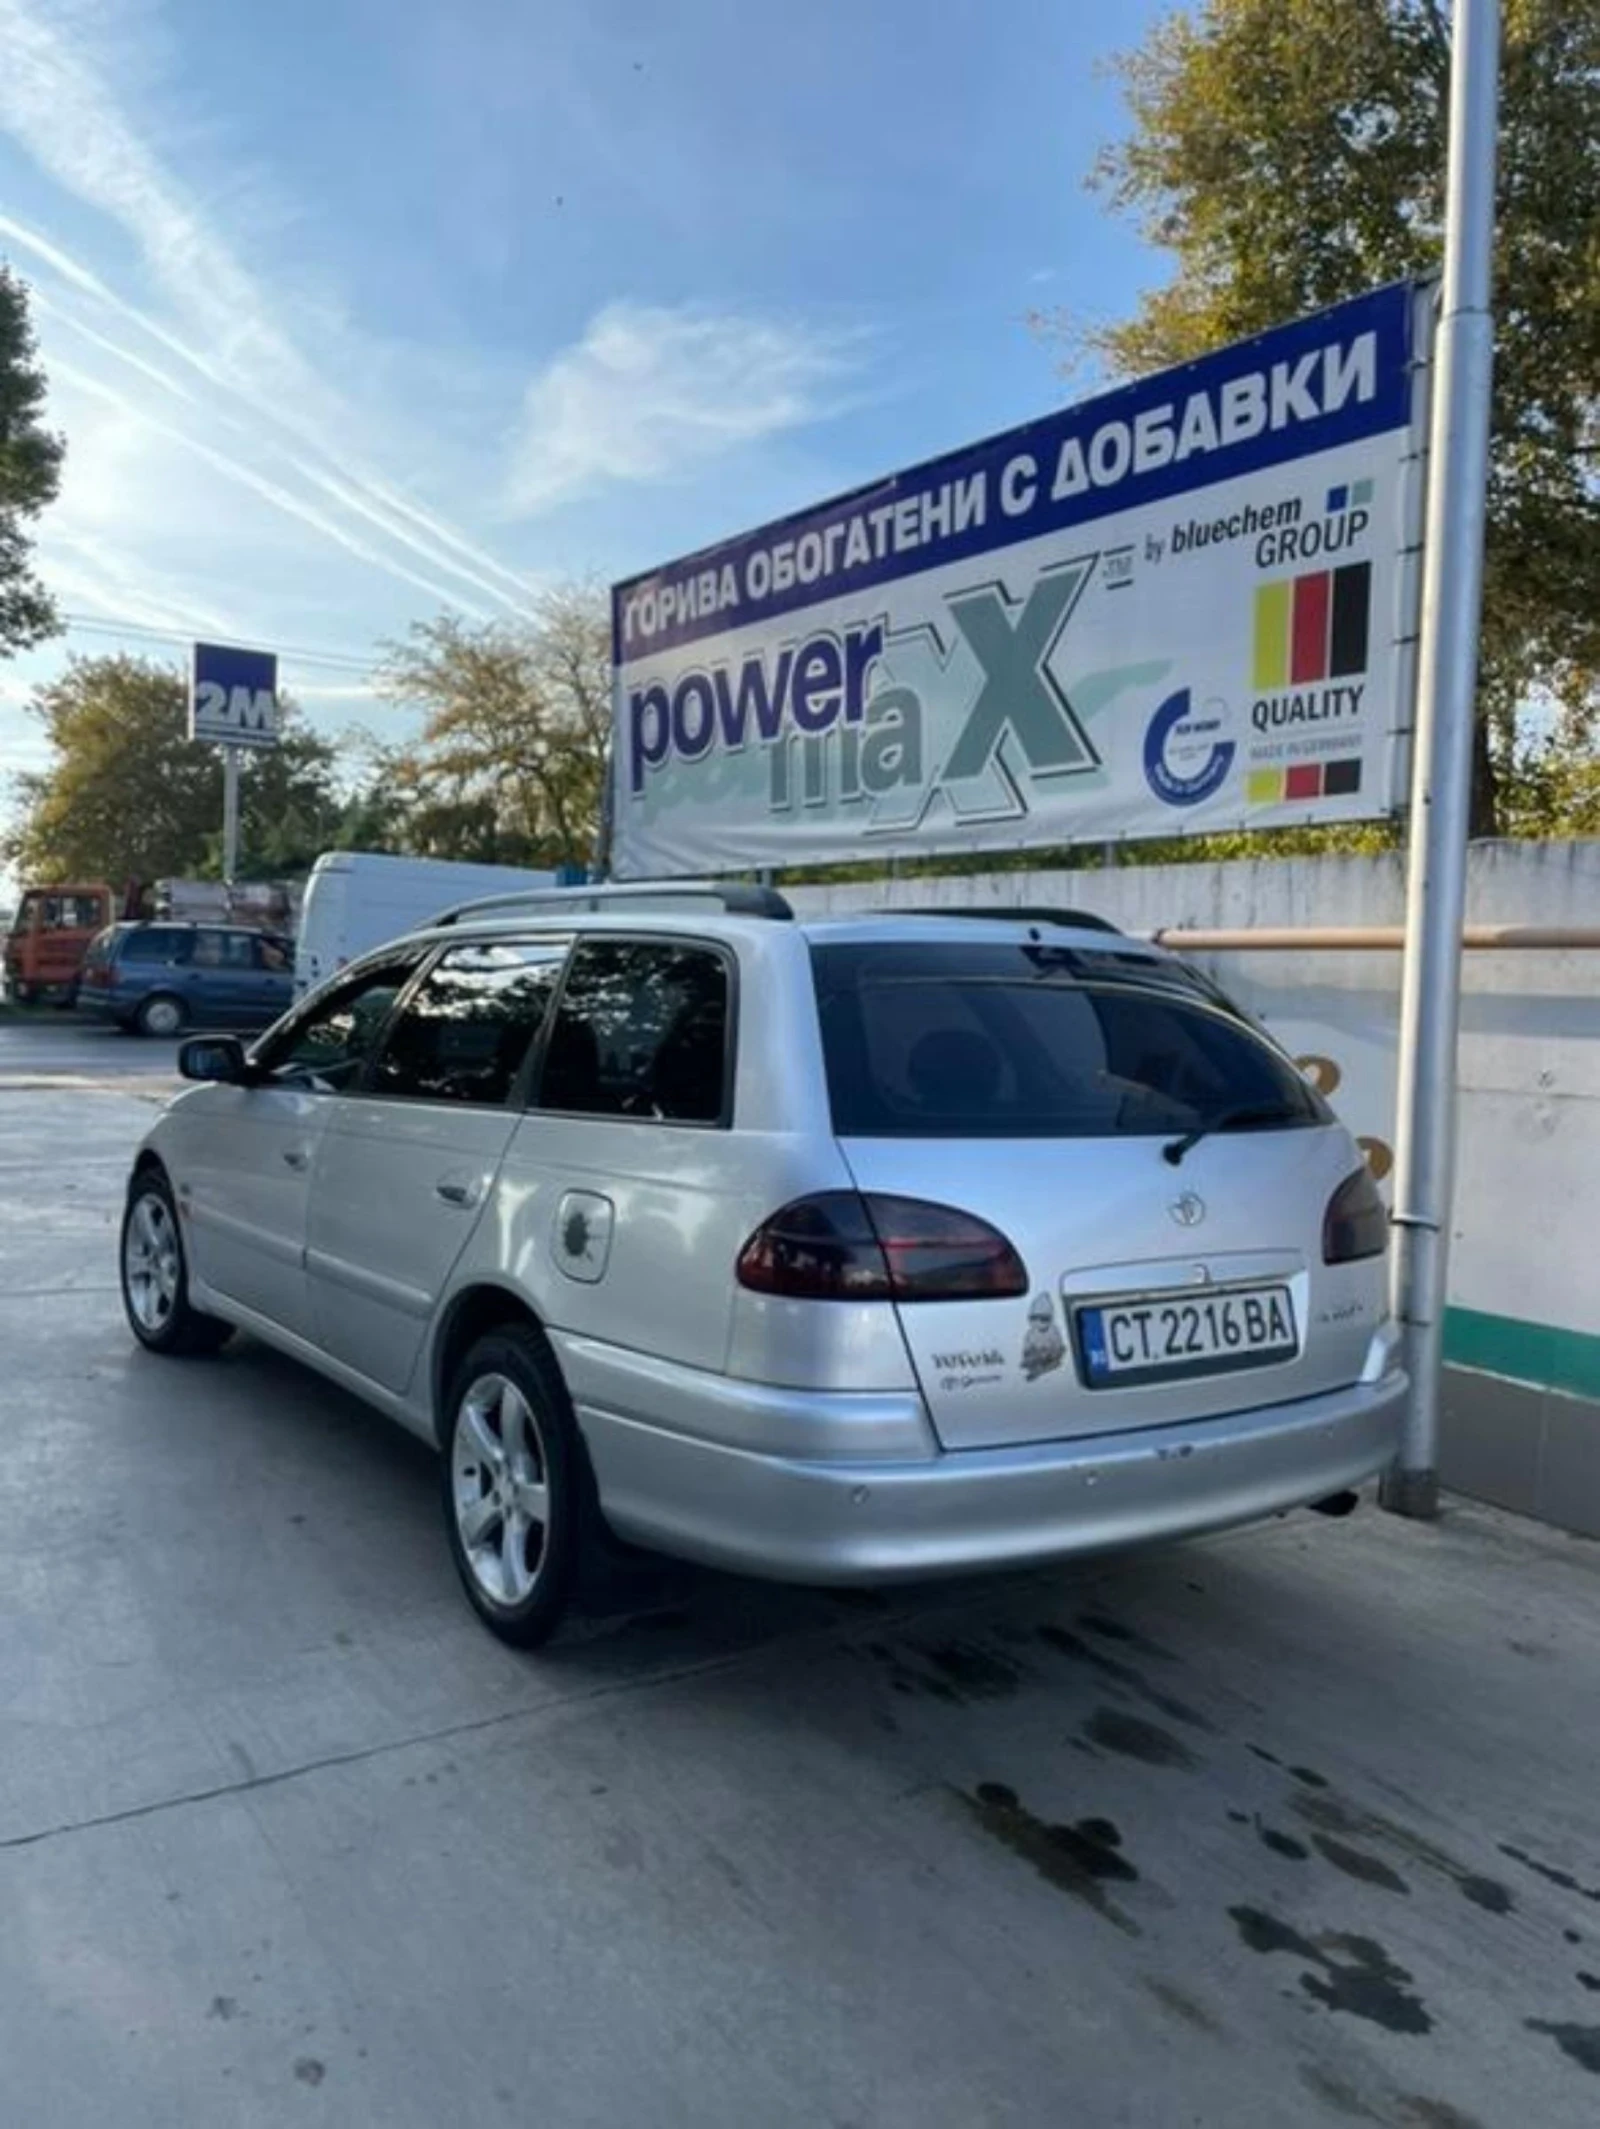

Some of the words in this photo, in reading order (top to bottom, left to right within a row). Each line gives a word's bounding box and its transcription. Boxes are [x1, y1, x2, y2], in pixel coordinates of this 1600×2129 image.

[623, 562, 740, 642] ГОРИВА
[746, 471, 987, 600] ОБОГАТЕНИ
[1002, 454, 1038, 516] С
[1051, 331, 1377, 501] ДОБАВКИ
[1171, 498, 1302, 553] bluechem
[1255, 510, 1369, 568] GROUP
[196, 681, 275, 730] 2M
[631, 624, 883, 793] power
[1252, 684, 1364, 733] QUALITY
[1161, 1302, 1241, 1355] 2216
